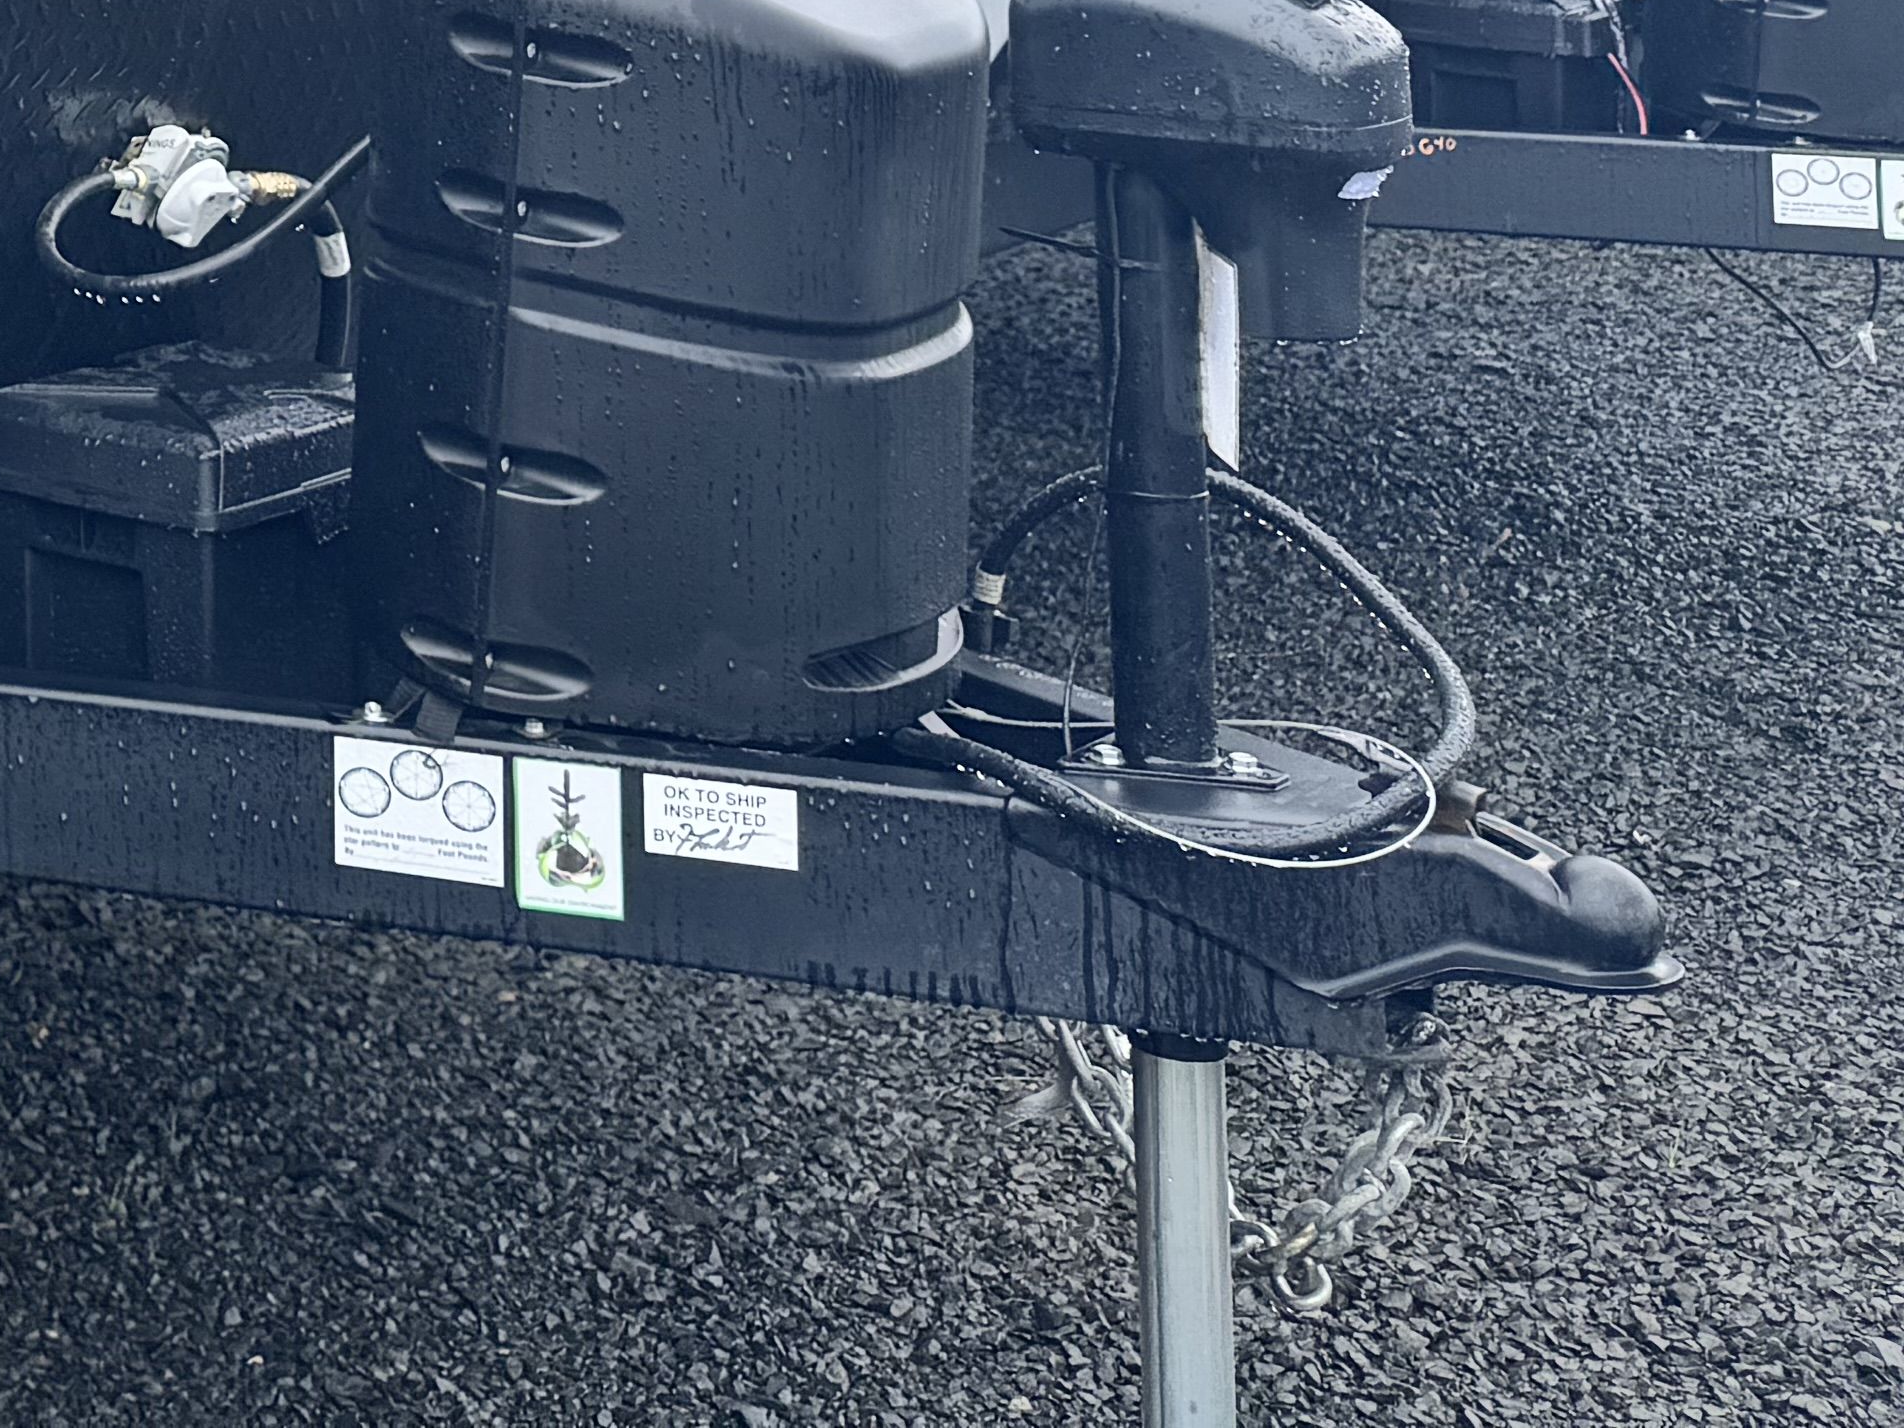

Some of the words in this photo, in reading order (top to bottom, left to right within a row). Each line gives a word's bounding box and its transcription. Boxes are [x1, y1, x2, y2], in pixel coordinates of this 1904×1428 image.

[664, 785, 690, 801] OK
[695, 789, 720, 804] TO
[725, 792, 767, 809] SHIP
[664, 804, 766, 827] INSPECTED
[653, 828, 676, 843] BY
